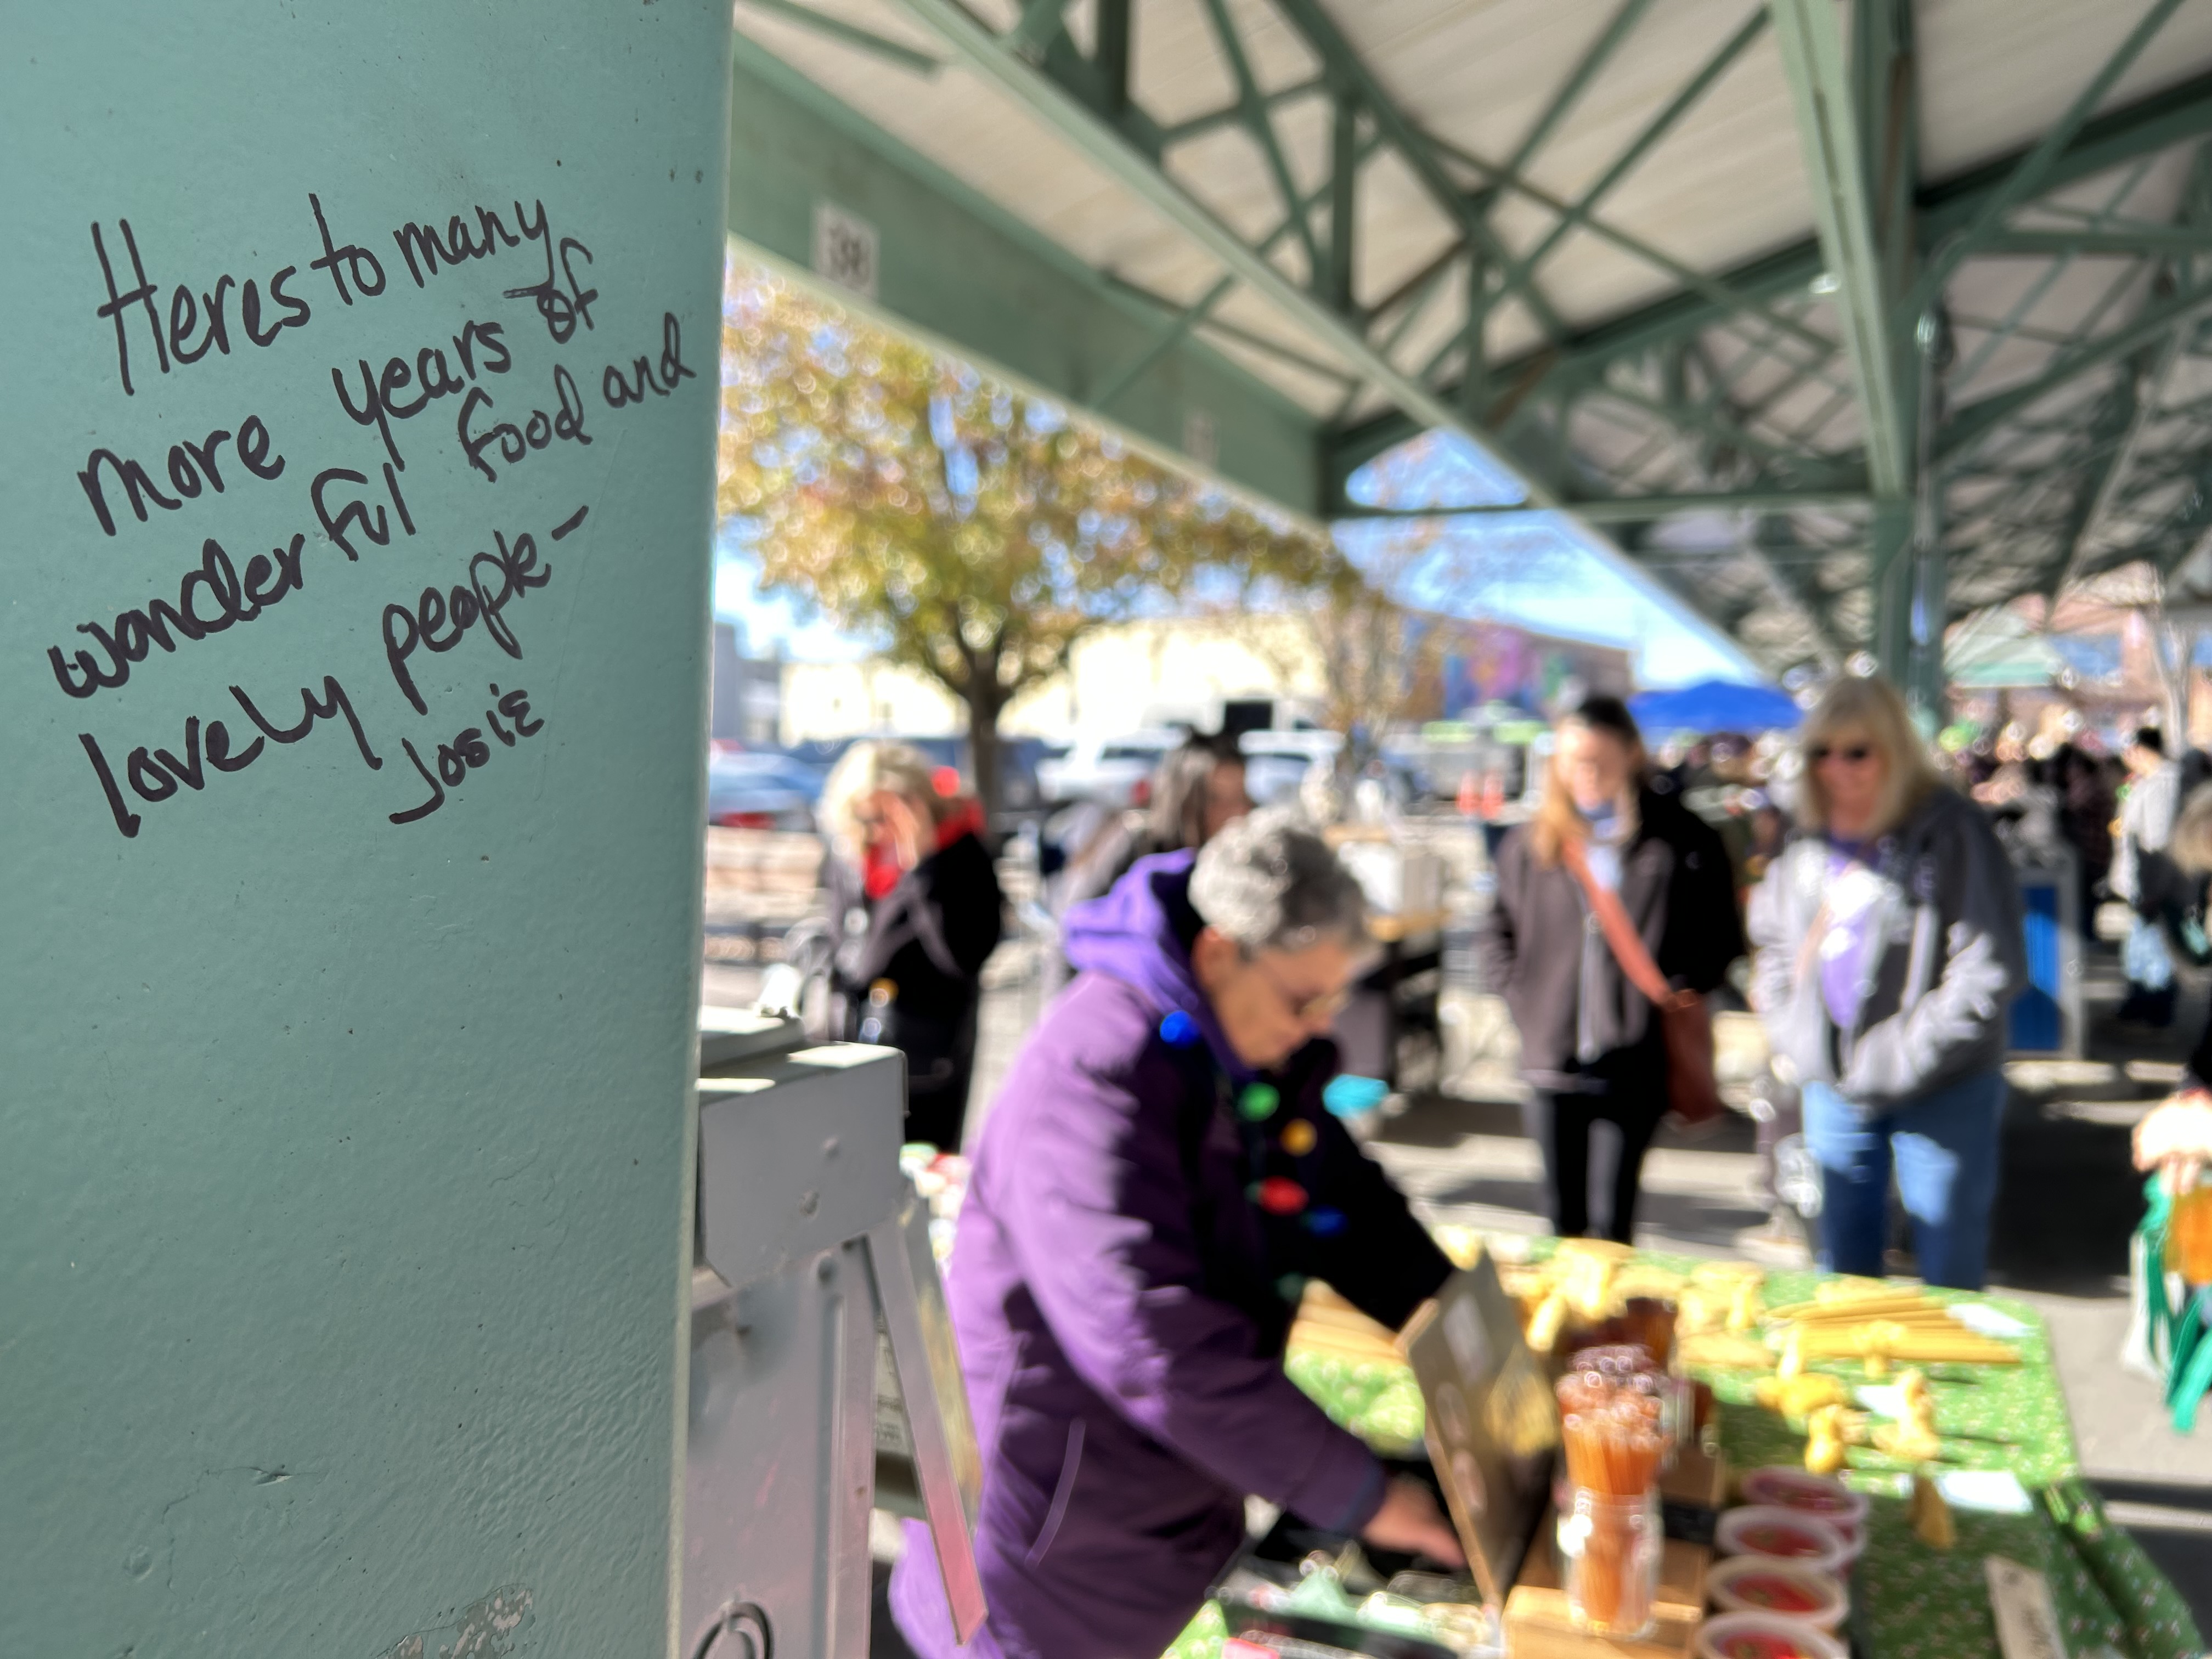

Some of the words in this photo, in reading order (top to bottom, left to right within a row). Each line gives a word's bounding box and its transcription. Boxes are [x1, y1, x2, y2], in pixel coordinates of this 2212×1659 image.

[77, 415, 286, 537] more
[331, 320, 511, 472] years
[536, 237, 599, 345] of
[91, 219, 311, 396] Heres
[308, 193, 386, 306] to
[392, 199, 555, 300] many
[458, 364, 592, 483] food
[603, 312, 696, 409] and
[78, 675, 383, 838] lovely
